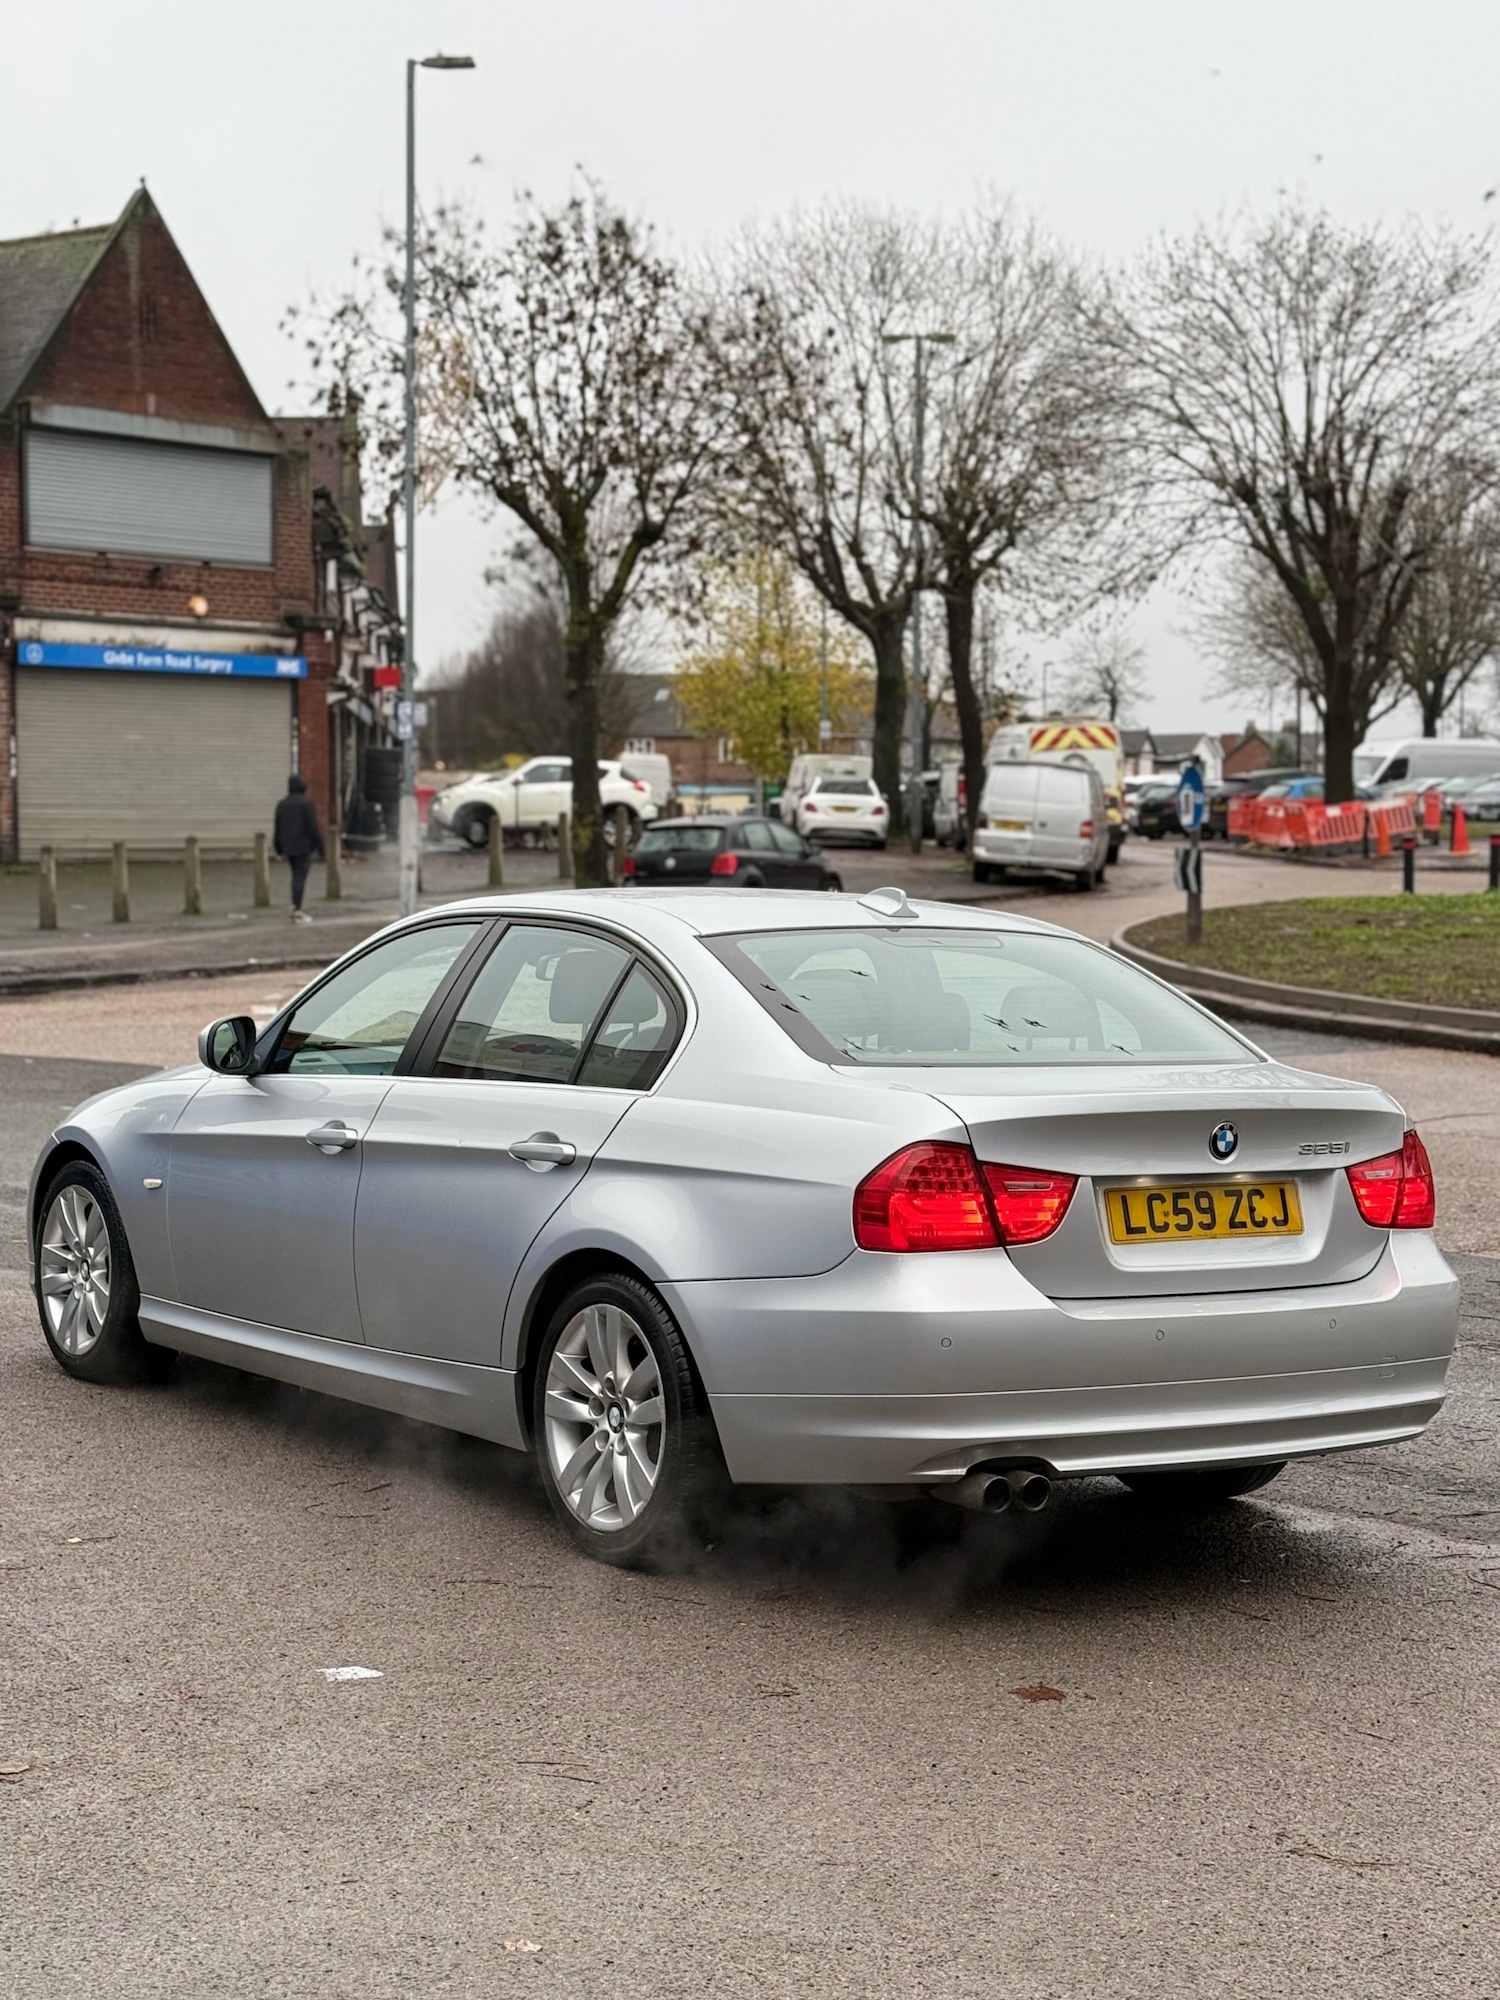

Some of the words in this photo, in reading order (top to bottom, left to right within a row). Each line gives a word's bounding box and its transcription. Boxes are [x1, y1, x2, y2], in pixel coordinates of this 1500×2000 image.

[164, 654, 192, 669] Road
[193, 655, 234, 674] Surgery
[276, 659, 300, 674] NHS
[1120, 1191, 1217, 1235] LC59
[1224, 1188, 1290, 1229] ZCJ
